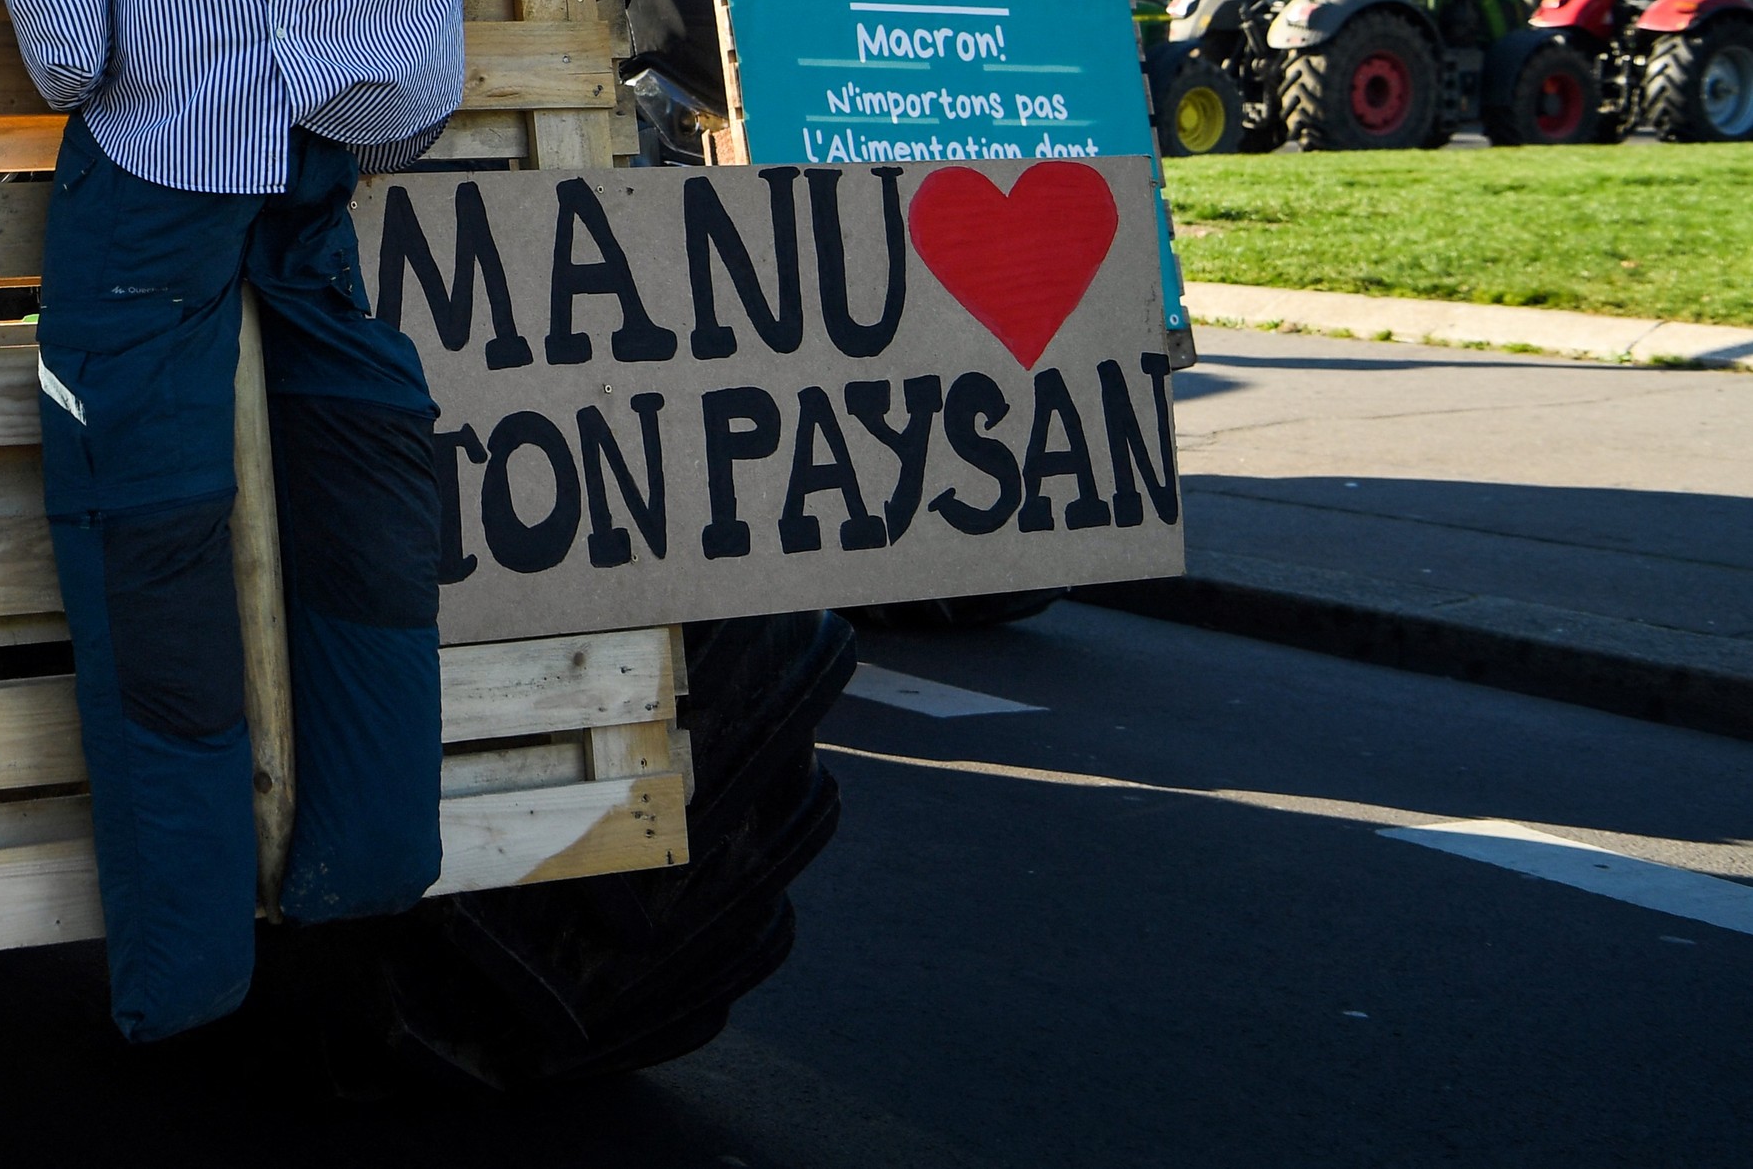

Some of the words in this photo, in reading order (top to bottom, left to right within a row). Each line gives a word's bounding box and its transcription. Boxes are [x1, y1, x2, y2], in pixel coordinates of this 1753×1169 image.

[856, 22, 1007, 63] Macron!
[826, 81, 1005, 124] N'importons
[1015, 93, 1069, 126] pas
[1035, 132, 1100, 161] dont
[375, 166, 908, 370] MANU
[701, 351, 1180, 561] PAYSAN
